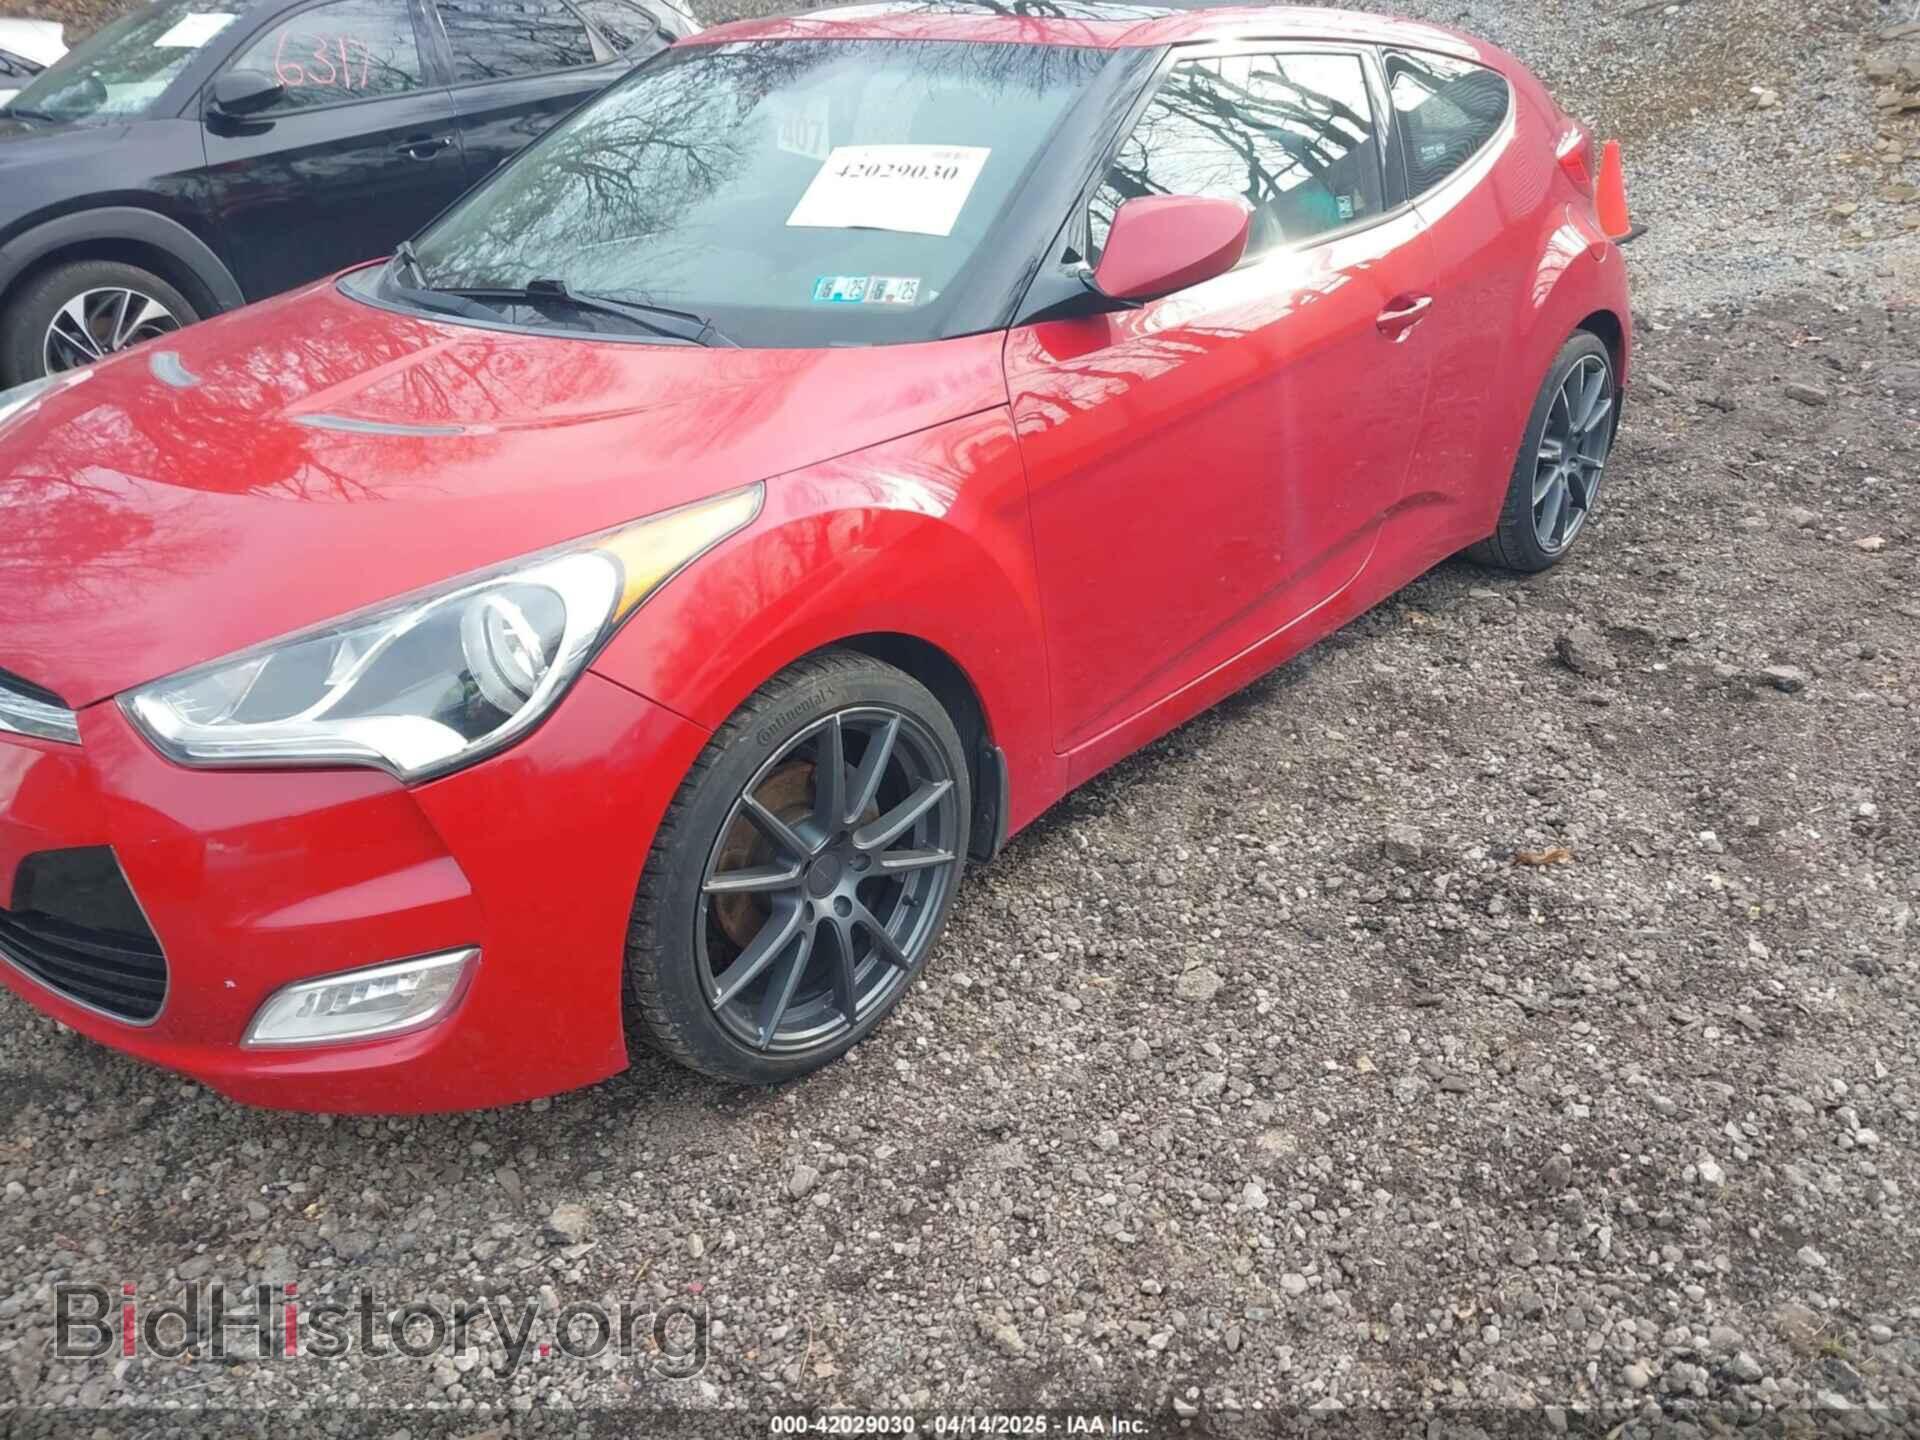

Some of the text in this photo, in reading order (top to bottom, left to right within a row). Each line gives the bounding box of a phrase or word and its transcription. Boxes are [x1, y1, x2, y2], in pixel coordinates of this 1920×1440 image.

[274, 31, 369, 89] 6317
[834, 163, 959, 181] 42029030
[756, 688, 828, 746] Continental
